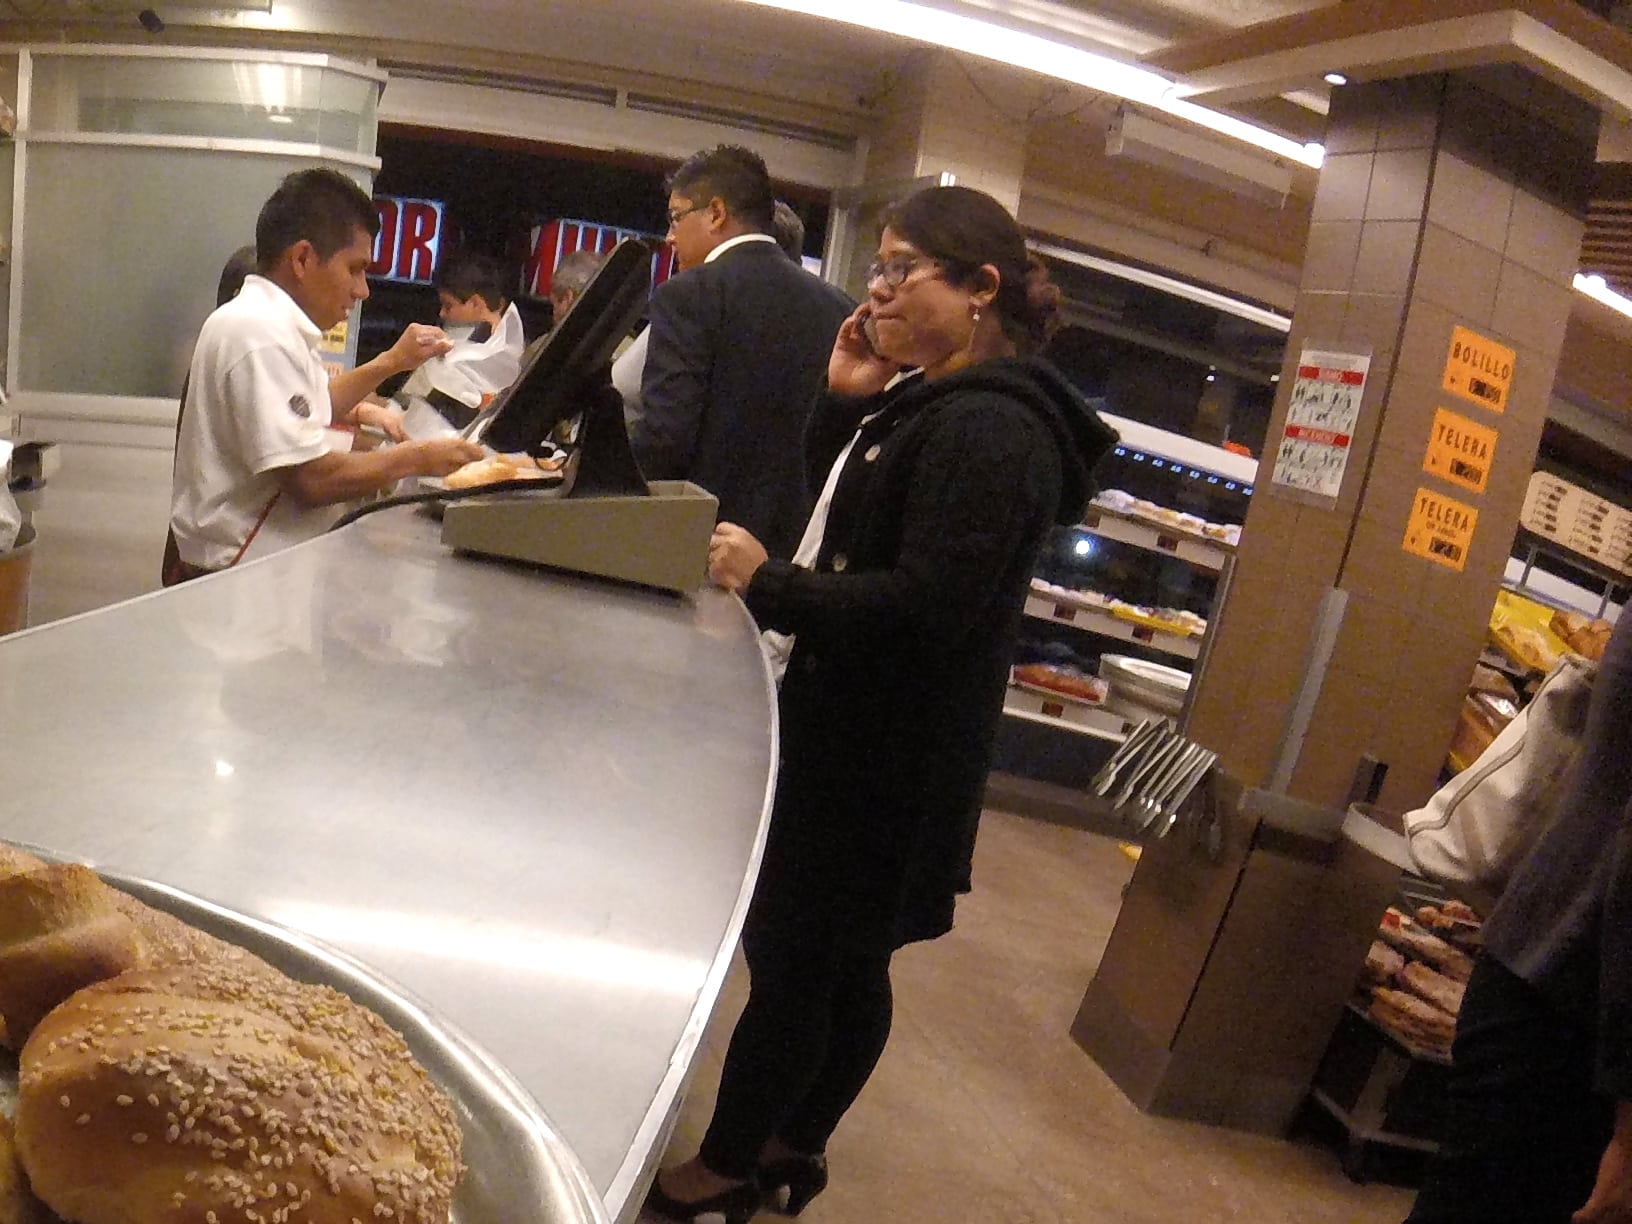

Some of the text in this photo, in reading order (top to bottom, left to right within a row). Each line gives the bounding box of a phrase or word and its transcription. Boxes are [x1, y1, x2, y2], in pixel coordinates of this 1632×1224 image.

[1452, 341, 1510, 380] BOLILLO
[1437, 423, 1487, 460] TELERA
[1419, 497, 1469, 533] TELERA
